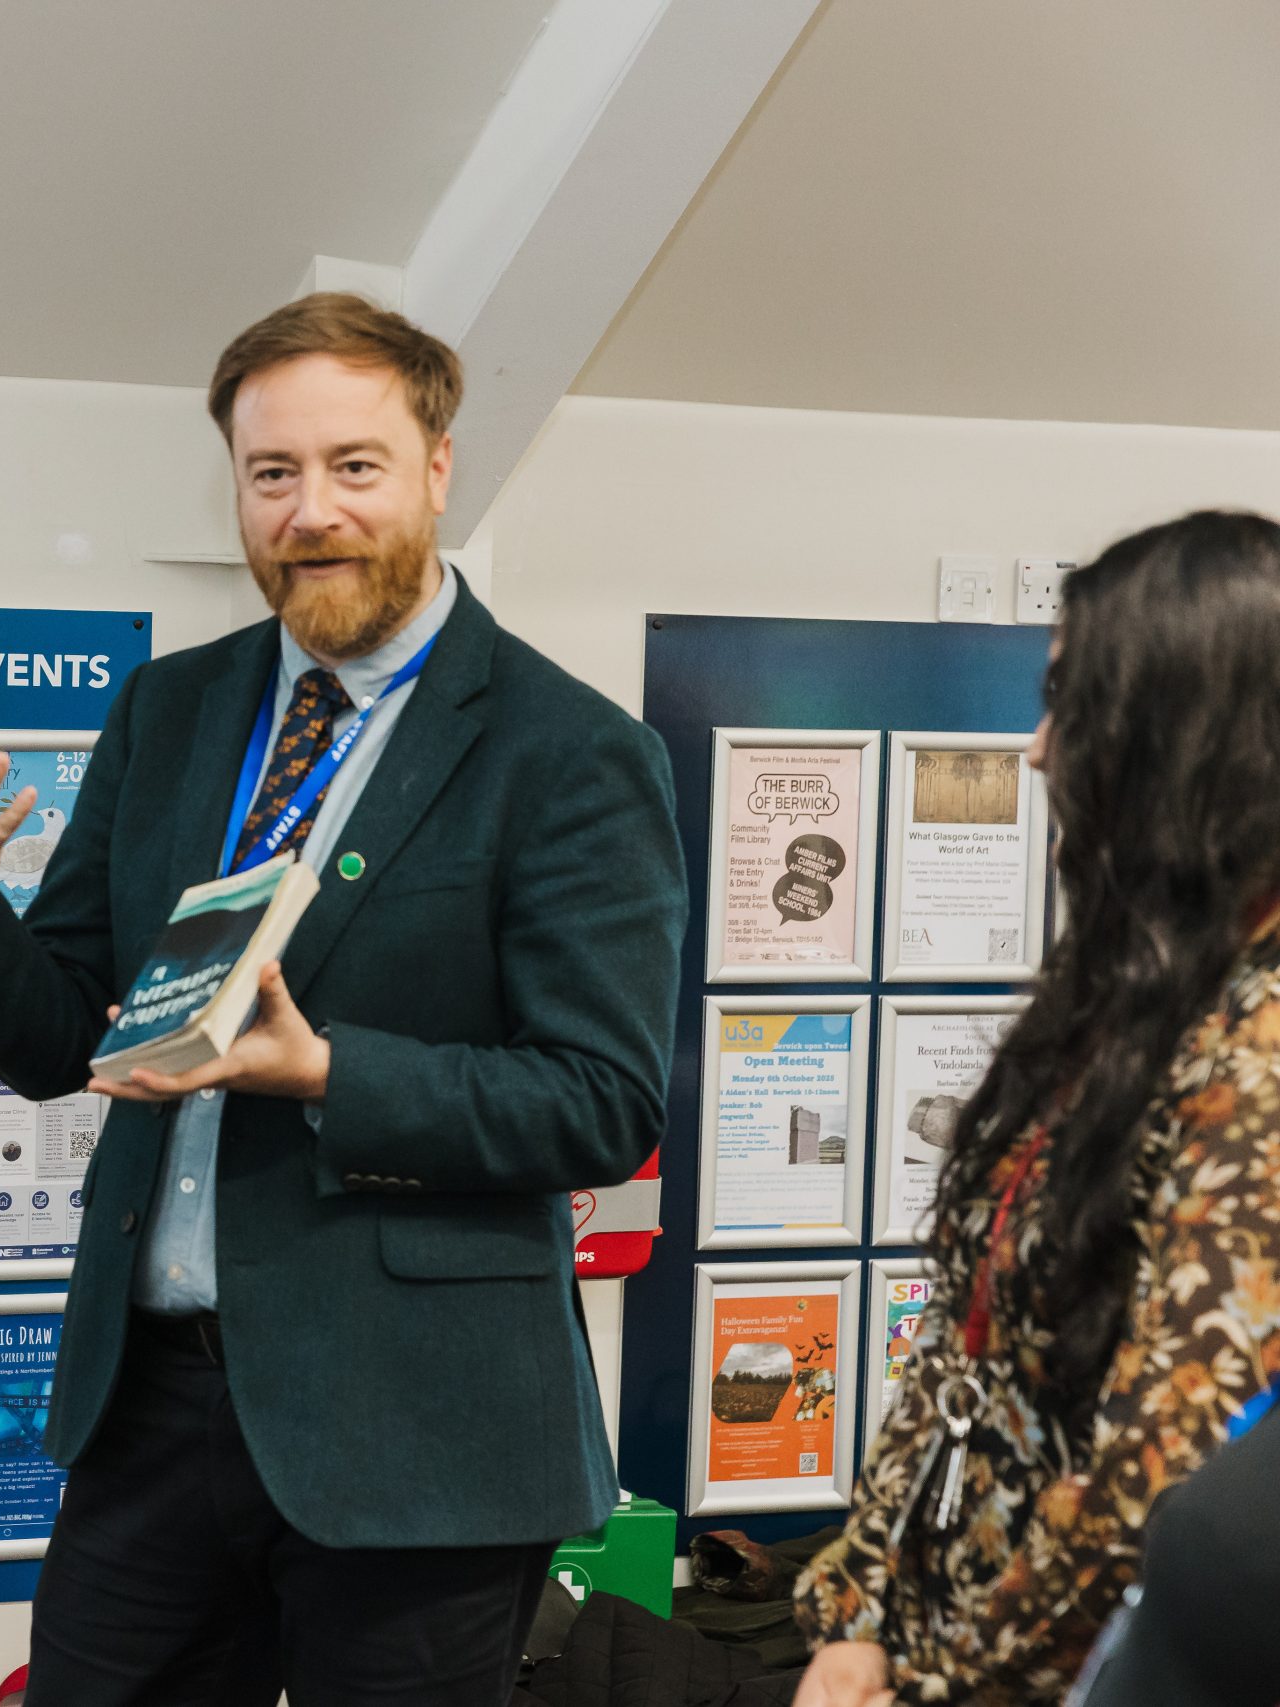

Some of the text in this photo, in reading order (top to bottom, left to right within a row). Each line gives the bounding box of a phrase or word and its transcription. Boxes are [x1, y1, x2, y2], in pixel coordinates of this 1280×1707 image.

[331, 720, 364, 761] STAFF
[763, 780, 823, 793] THE BURR
[756, 797, 830, 810] OF BERWICK
[266, 805, 301, 850] STAFF
[731, 824, 769, 833] Community
[731, 835, 770, 845] Film Library
[909, 832, 930, 840] What
[933, 832, 969, 842] Glasgow
[973, 833, 993, 841] Gave
[939, 846, 963, 854] World
[731, 857, 755, 865] Browse
[794, 846, 837, 867] AMBER FILMS
[798, 857, 829, 873] CURRENT
[747, 869, 764, 878] Entry
[789, 863, 832, 883] AFFAIRS UNIT
[787, 890, 818, 907] WEEKEND
[902, 927, 933, 946] BEA
[726, 1021, 764, 1040] u3a
[918, 1046, 974, 1055] Recent Finds
[744, 1056, 824, 1068] Open Meeting
[934, 1060, 983, 1069] Vindolanda
[732, 1075, 764, 1084] Monday
[721, 1318, 760, 1326] Halloween
[762, 1317, 787, 1325] Family
[721, 1326, 788, 1336] Day Extravaganza!
[38, 1352, 57, 1362] JENN
